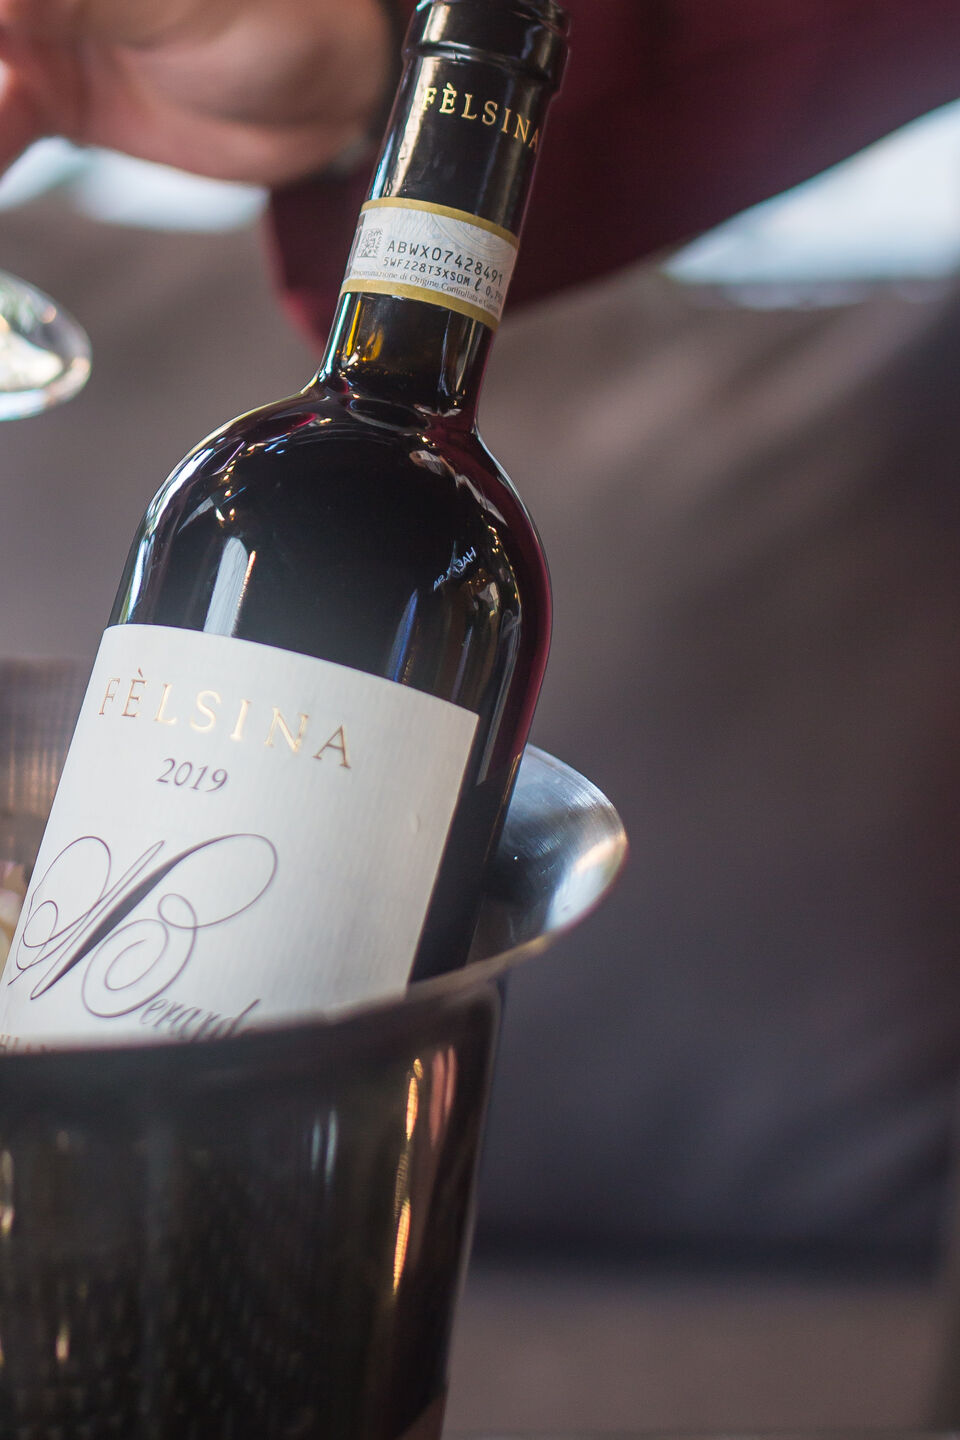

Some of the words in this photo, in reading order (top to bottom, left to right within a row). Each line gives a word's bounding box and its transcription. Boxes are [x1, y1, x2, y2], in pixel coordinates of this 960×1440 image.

[421, 82, 539, 153] FÈLSINA
[98, 667, 352, 770] FÈLSINA
[156, 757, 229, 793] 2019
